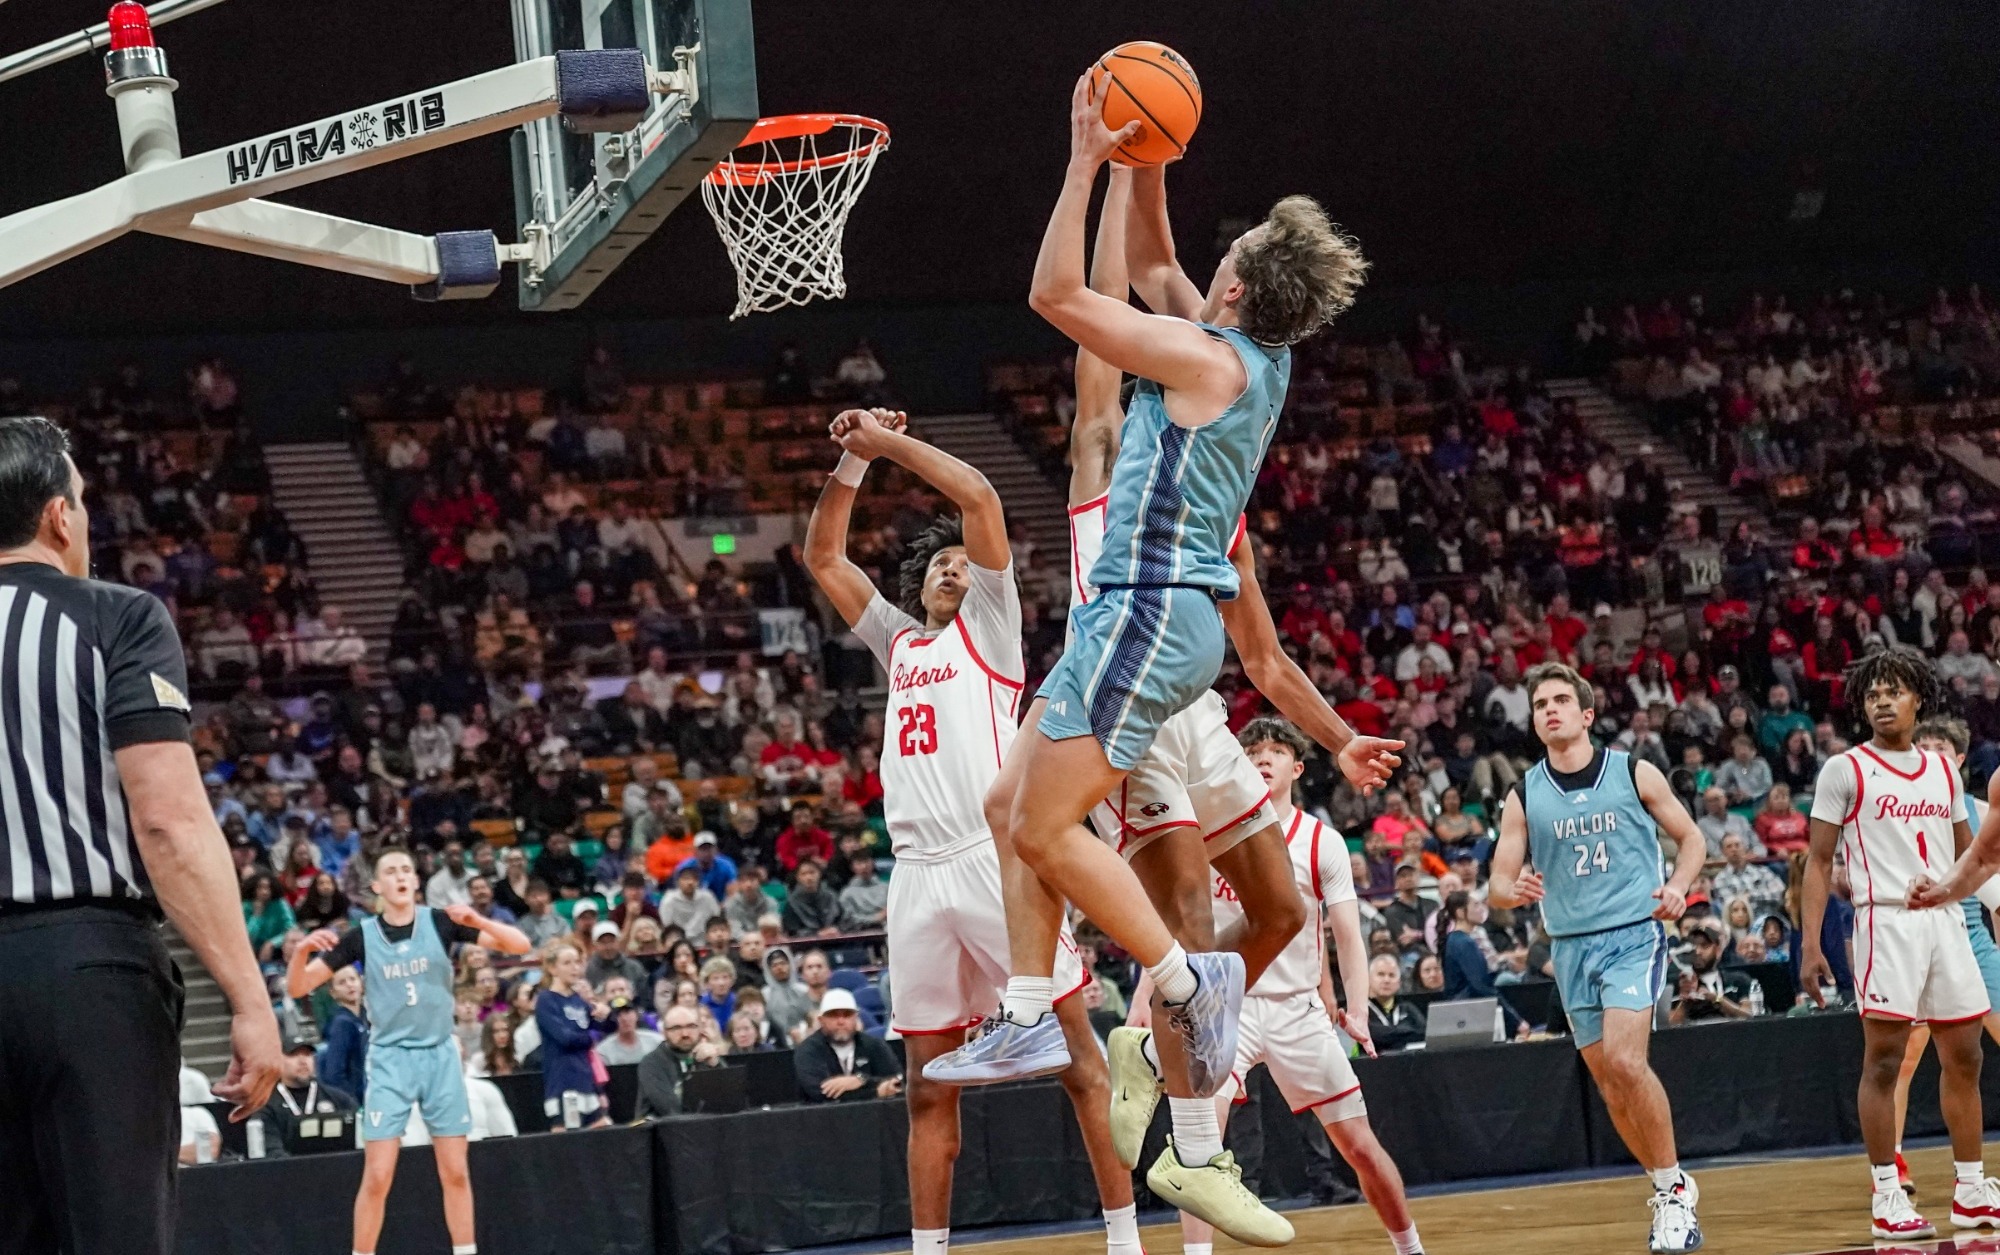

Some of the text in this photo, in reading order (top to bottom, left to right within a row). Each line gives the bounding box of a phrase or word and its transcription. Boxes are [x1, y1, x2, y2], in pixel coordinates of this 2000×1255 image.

[349, 111, 378, 131] SURE
[227, 91, 446, 184] HYDRA RIB
[350, 130, 379, 150] SHOT
[1689, 557, 1722, 585] 128
[897, 703, 939, 757] 23
[1874, 794, 1951, 824] Raptors
[1553, 811, 1617, 840] VALOR
[1573, 840, 1610, 877] 24
[1916, 831, 1930, 869] 1
[382, 957, 429, 980] VALOR
[404, 981, 418, 1008] 3
